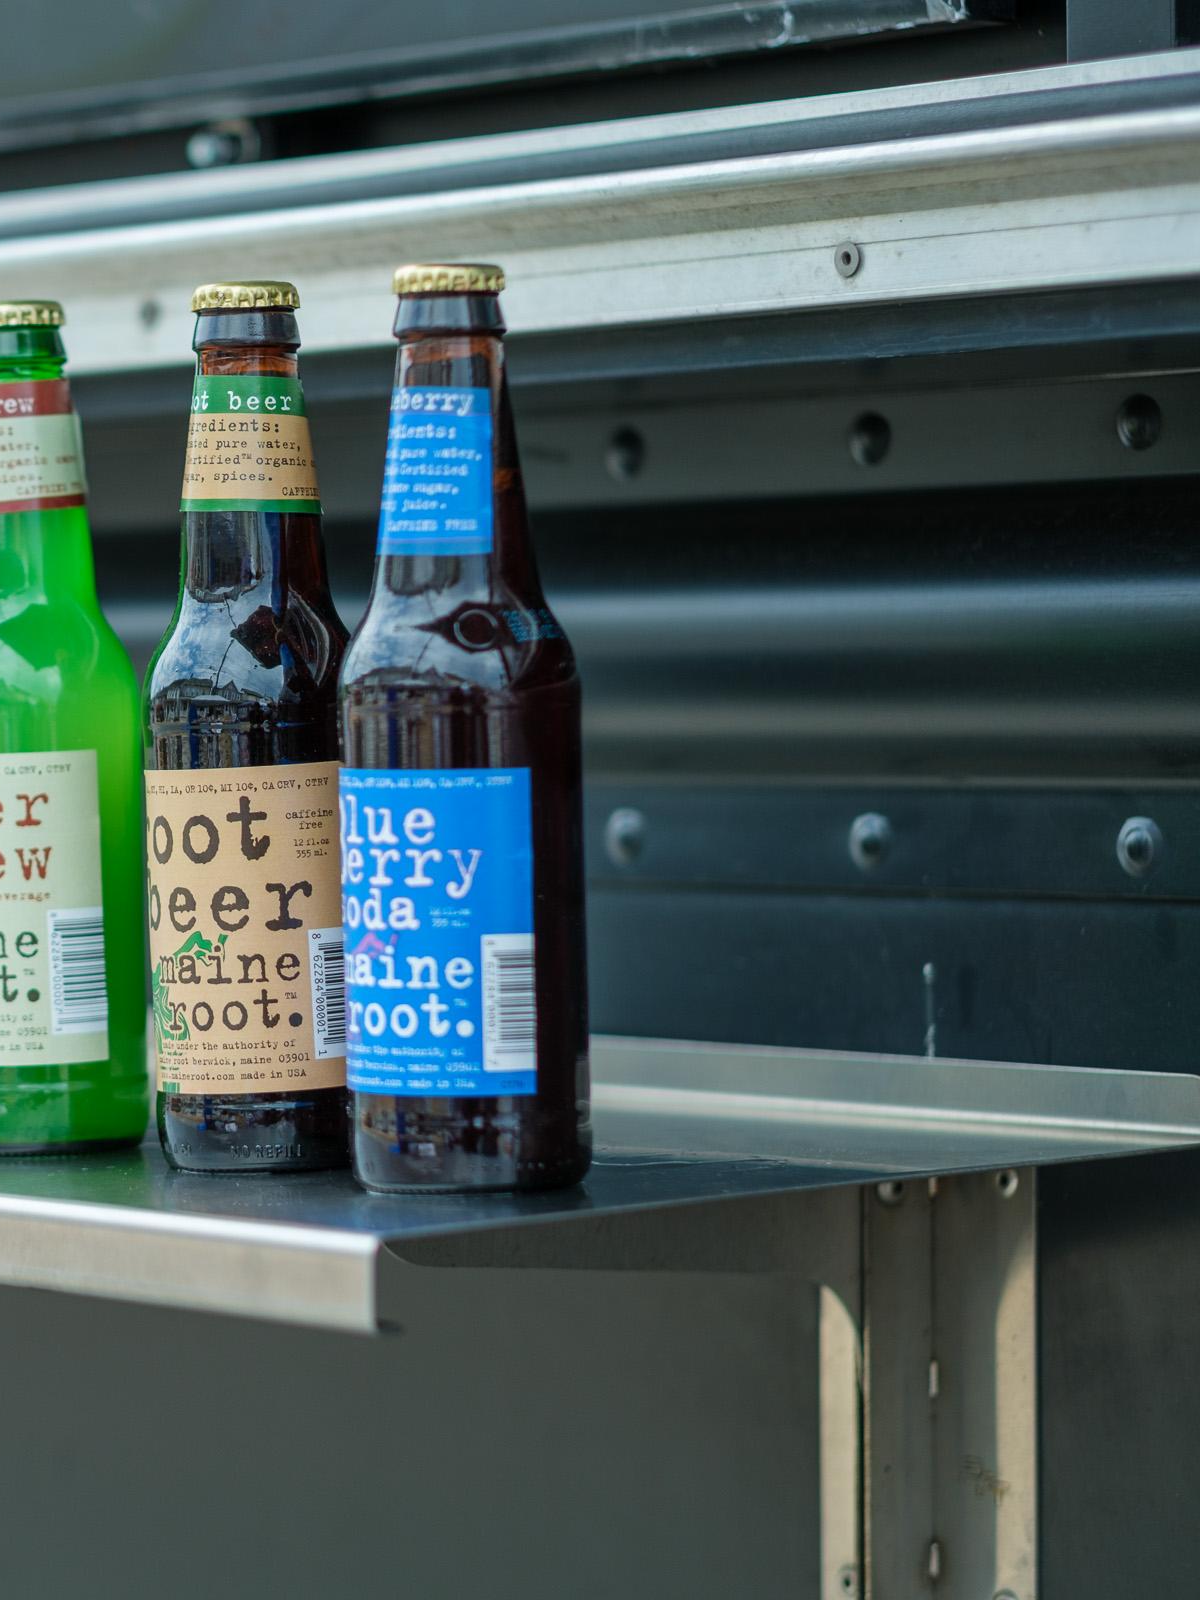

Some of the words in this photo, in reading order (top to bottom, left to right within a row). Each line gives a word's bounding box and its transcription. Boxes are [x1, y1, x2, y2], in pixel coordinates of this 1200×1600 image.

[227, 391, 292, 410] beer
[216, 440, 248, 450] pure
[257, 440, 301, 452] water,
[256, 457, 307, 468] organic
[213, 471, 273, 483] spices.
[220, 783, 233, 793] MI
[305, 777, 330, 787] CTRV
[285, 808, 333, 820] caffeine
[147, 796, 271, 864] oot
[299, 821, 323, 830] free
[295, 849, 312, 859] 355
[313, 848, 328, 857] ml.
[147, 868, 313, 932] beer
[342, 887, 421, 930] oda
[312, 932, 322, 940] 8
[159, 945, 301, 985] maine
[313, 954, 324, 993] 62284
[168, 988, 303, 1032] root.
[315, 997, 327, 1035] 00001
[348, 993, 475, 1038] root.
[176, 1041, 199, 1051] under
[202, 1041, 219, 1050] the
[222, 1039, 279, 1051] authority
[283, 1038, 297, 1048] of
[192, 1056, 236, 1067] berwick,
[240, 1056, 272, 1065] maine
[279, 1052, 311, 1063] 03901
[240, 1071, 266, 1080] made
[270, 1070, 283, 1078] in
[287, 1068, 307, 1078] USA
